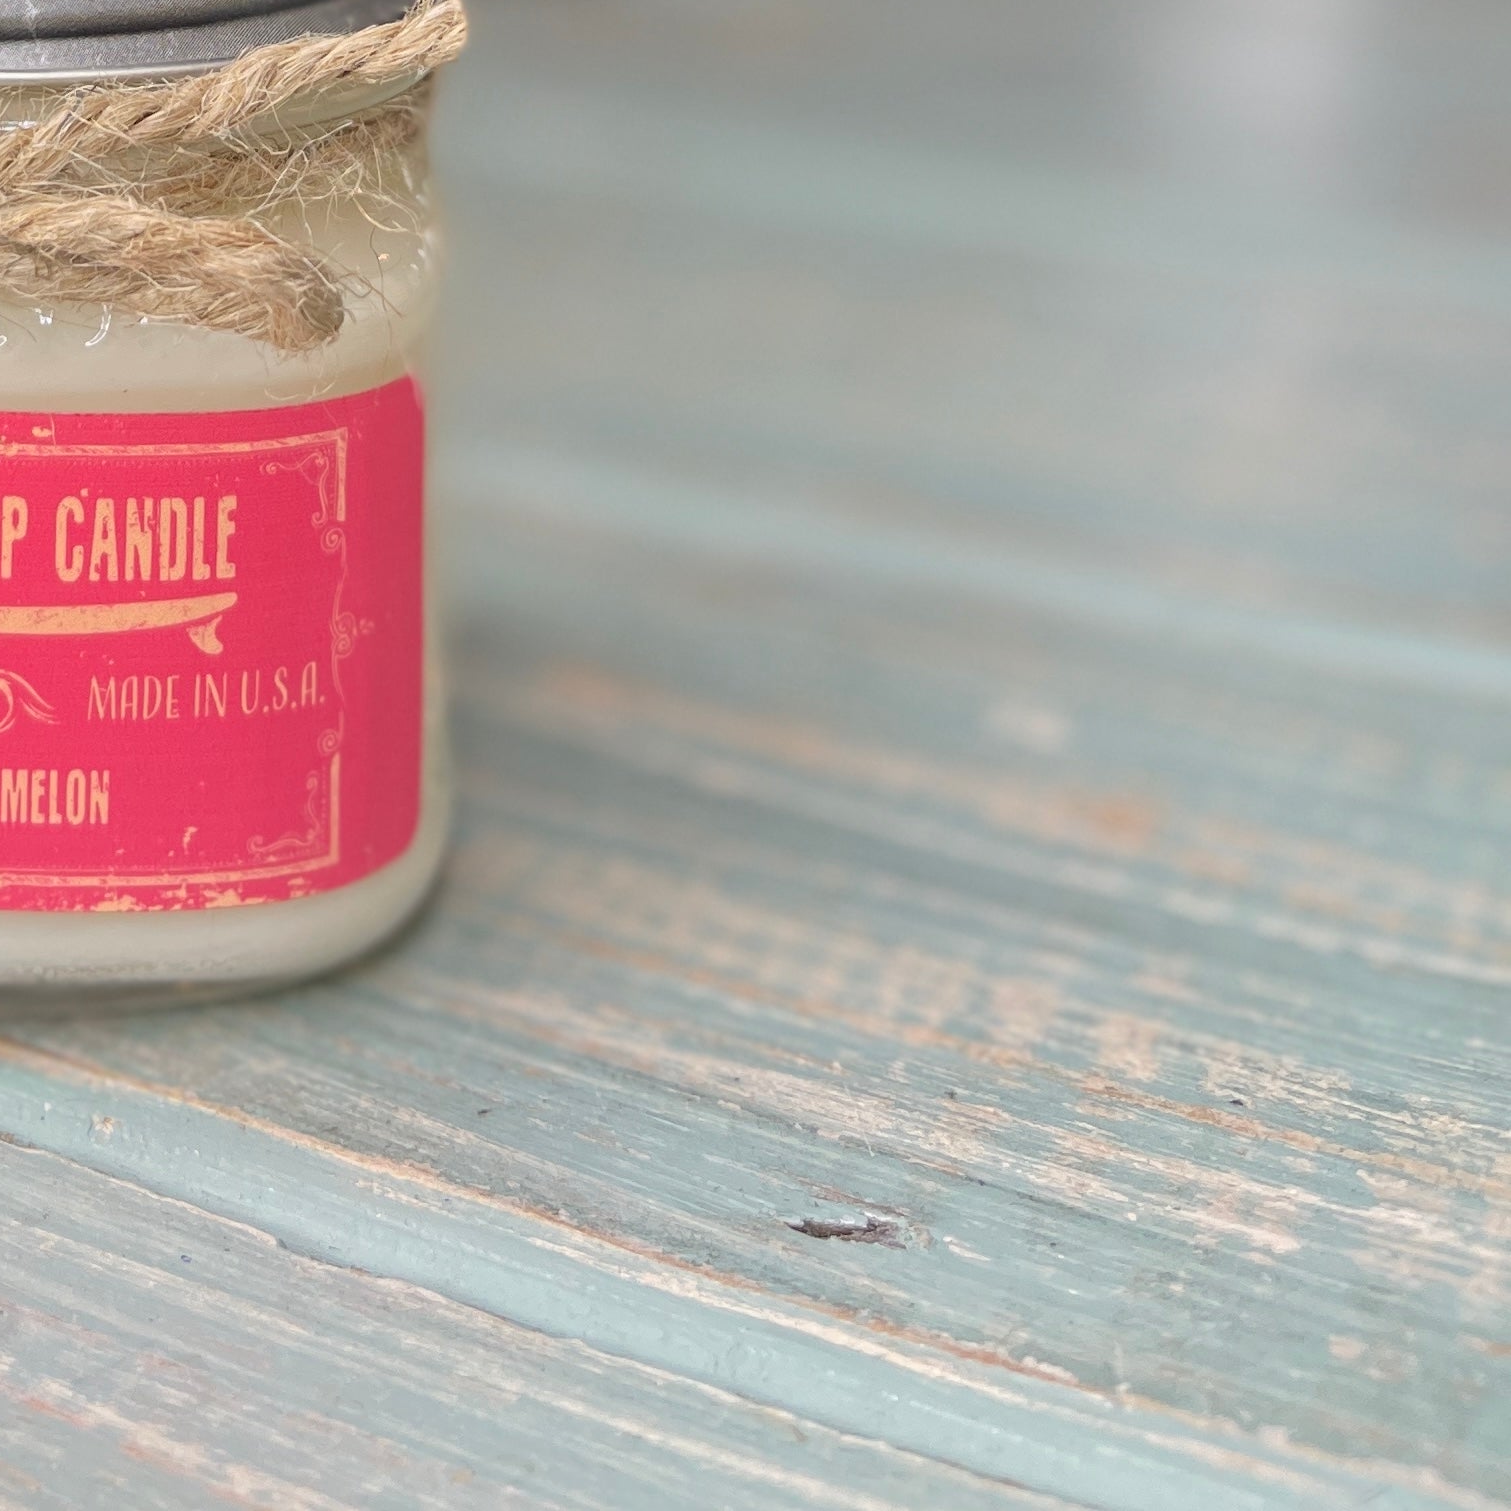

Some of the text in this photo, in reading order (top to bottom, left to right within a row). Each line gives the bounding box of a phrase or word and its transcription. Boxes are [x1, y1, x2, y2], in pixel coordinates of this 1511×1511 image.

[54, 491, 238, 583] CANDLE
[87, 660, 326, 720] MADE IN U.S.A.
